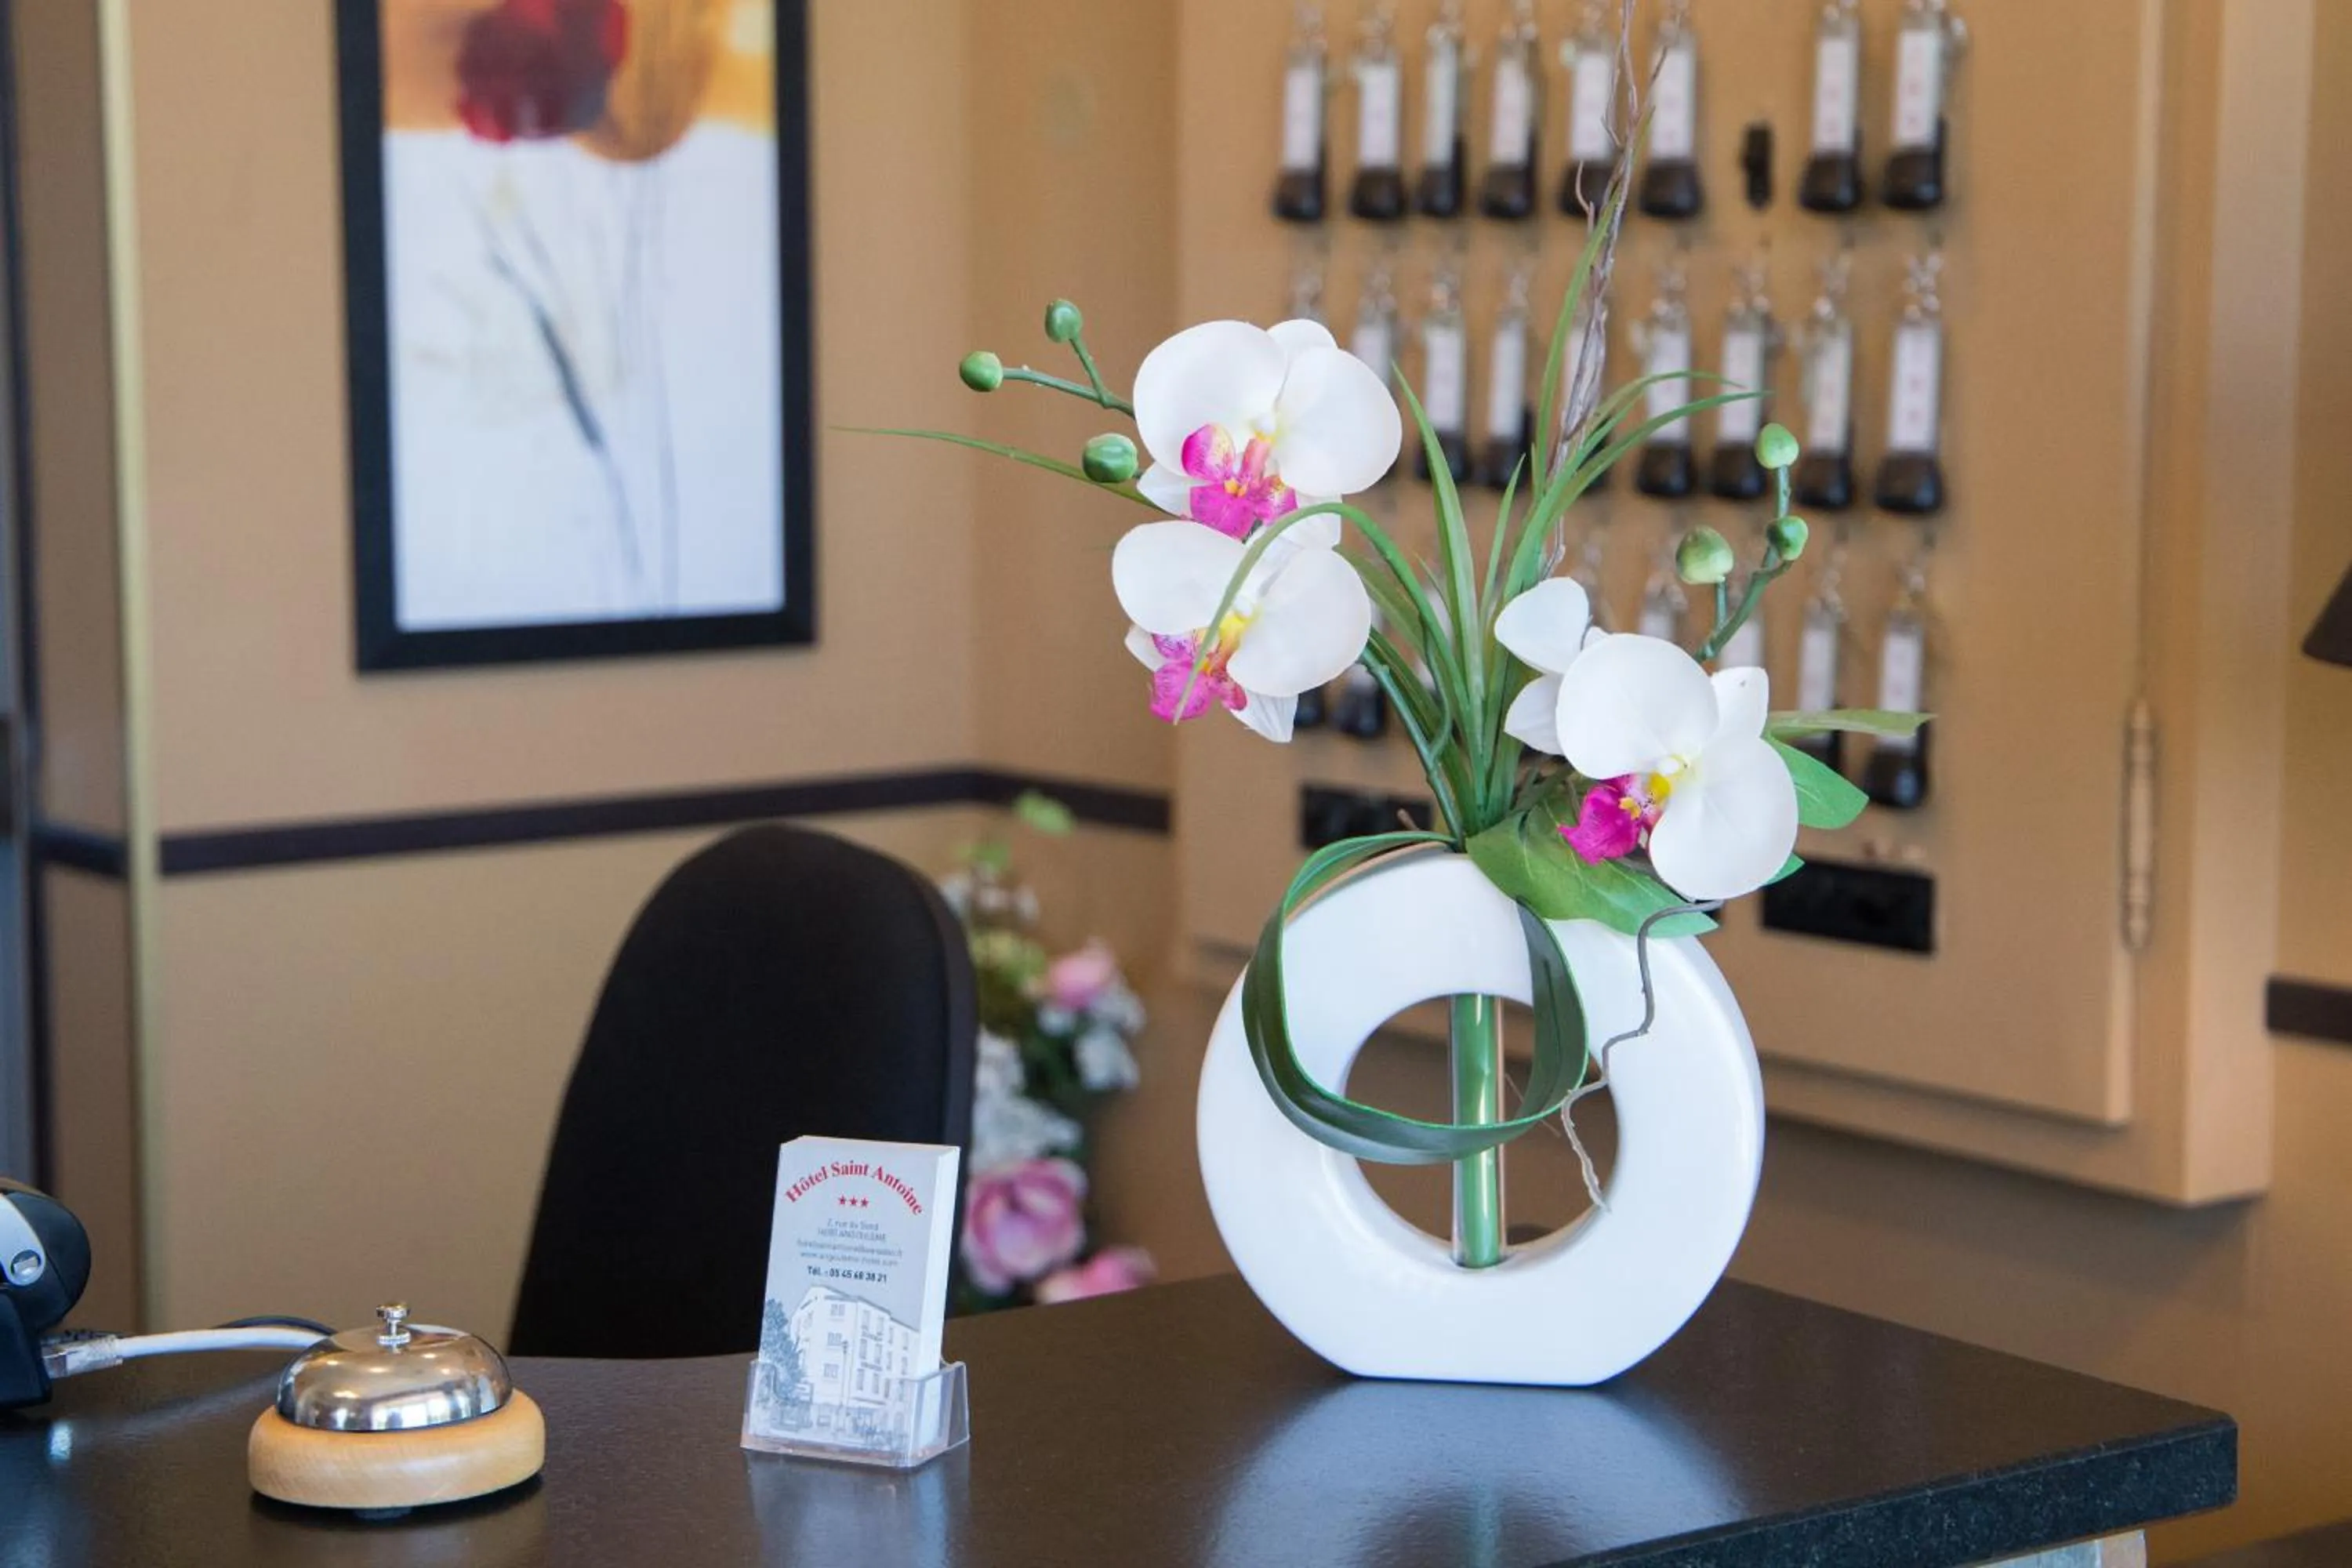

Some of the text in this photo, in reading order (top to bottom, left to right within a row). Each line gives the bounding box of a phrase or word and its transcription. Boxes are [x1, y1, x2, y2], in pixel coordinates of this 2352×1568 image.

[786, 1160, 923, 1215] Hôtel Saint Antoine
[829, 1268, 840, 1277] 05
[841, 1269, 852, 1279] 45
[866, 1272, 876, 1282] 38
[877, 1273, 887, 1283] 21
